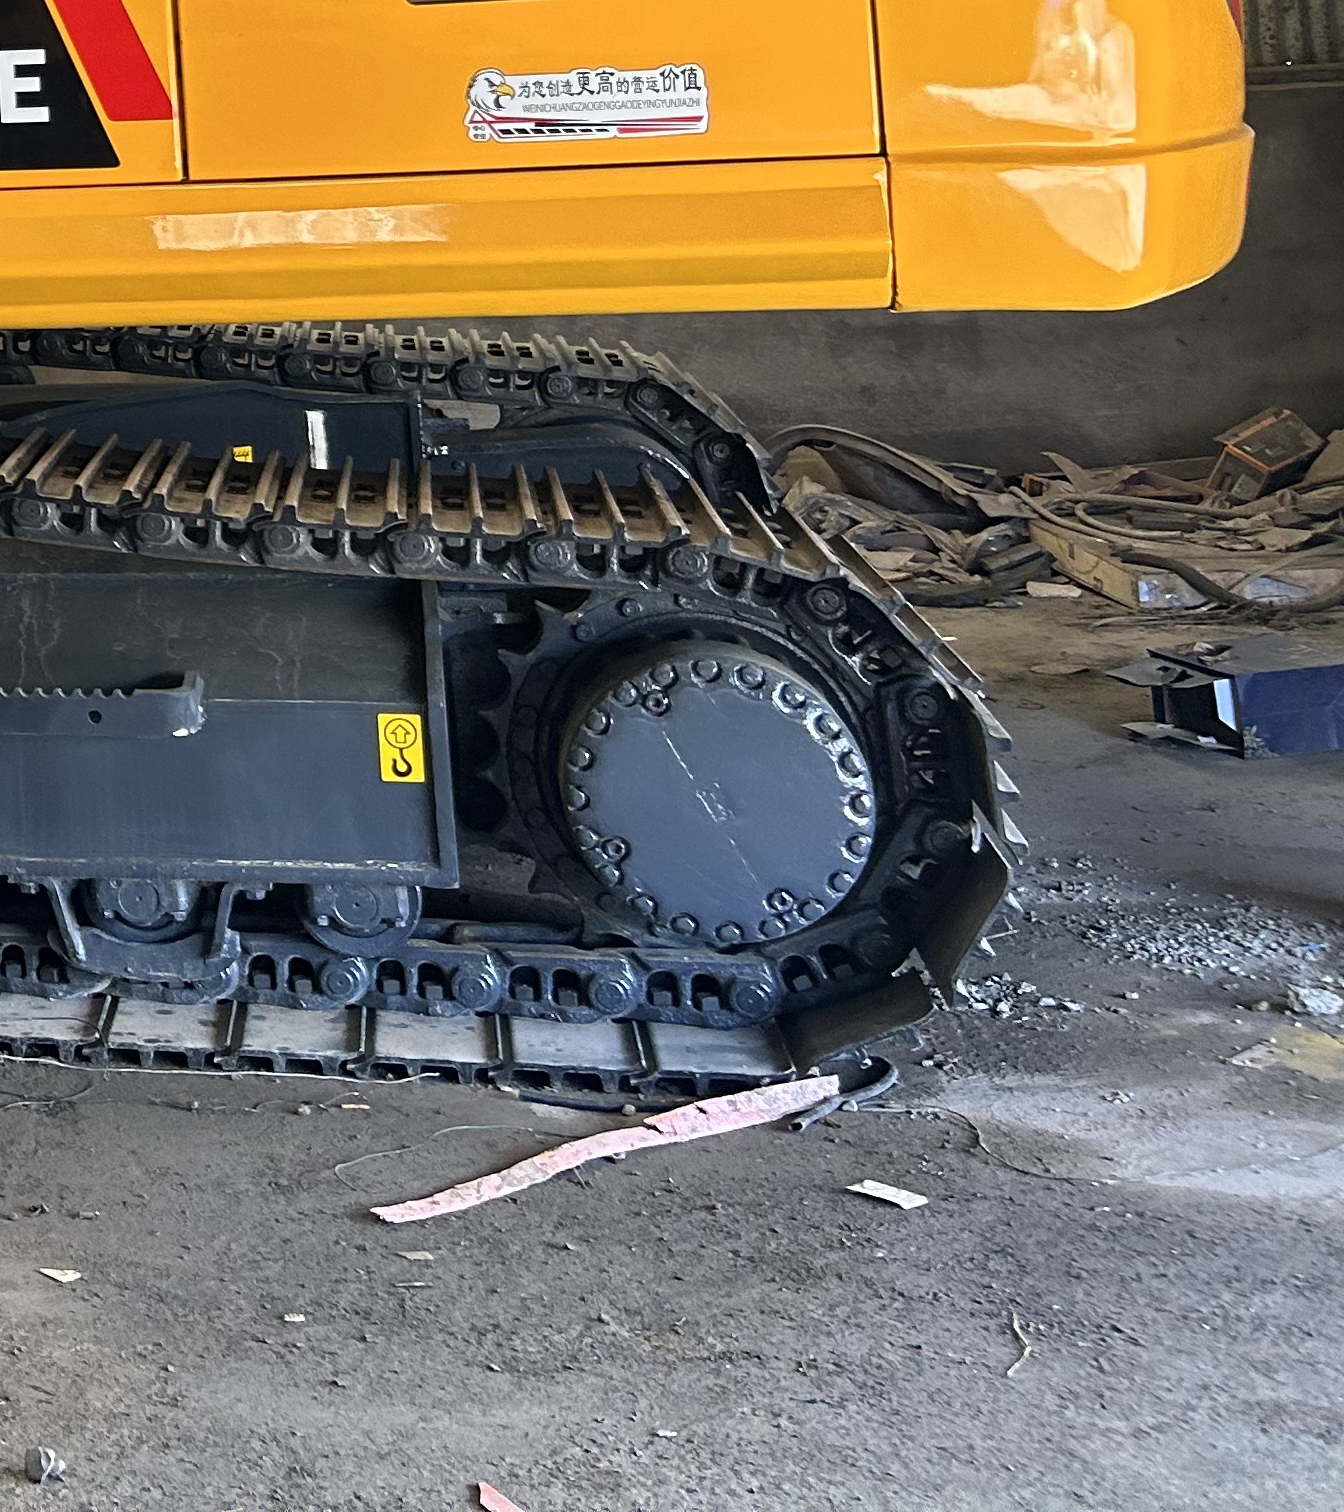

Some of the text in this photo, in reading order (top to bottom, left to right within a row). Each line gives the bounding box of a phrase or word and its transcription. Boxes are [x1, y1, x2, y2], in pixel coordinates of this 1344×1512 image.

[517, 66, 702, 98] 为您创造更高的营运价值
